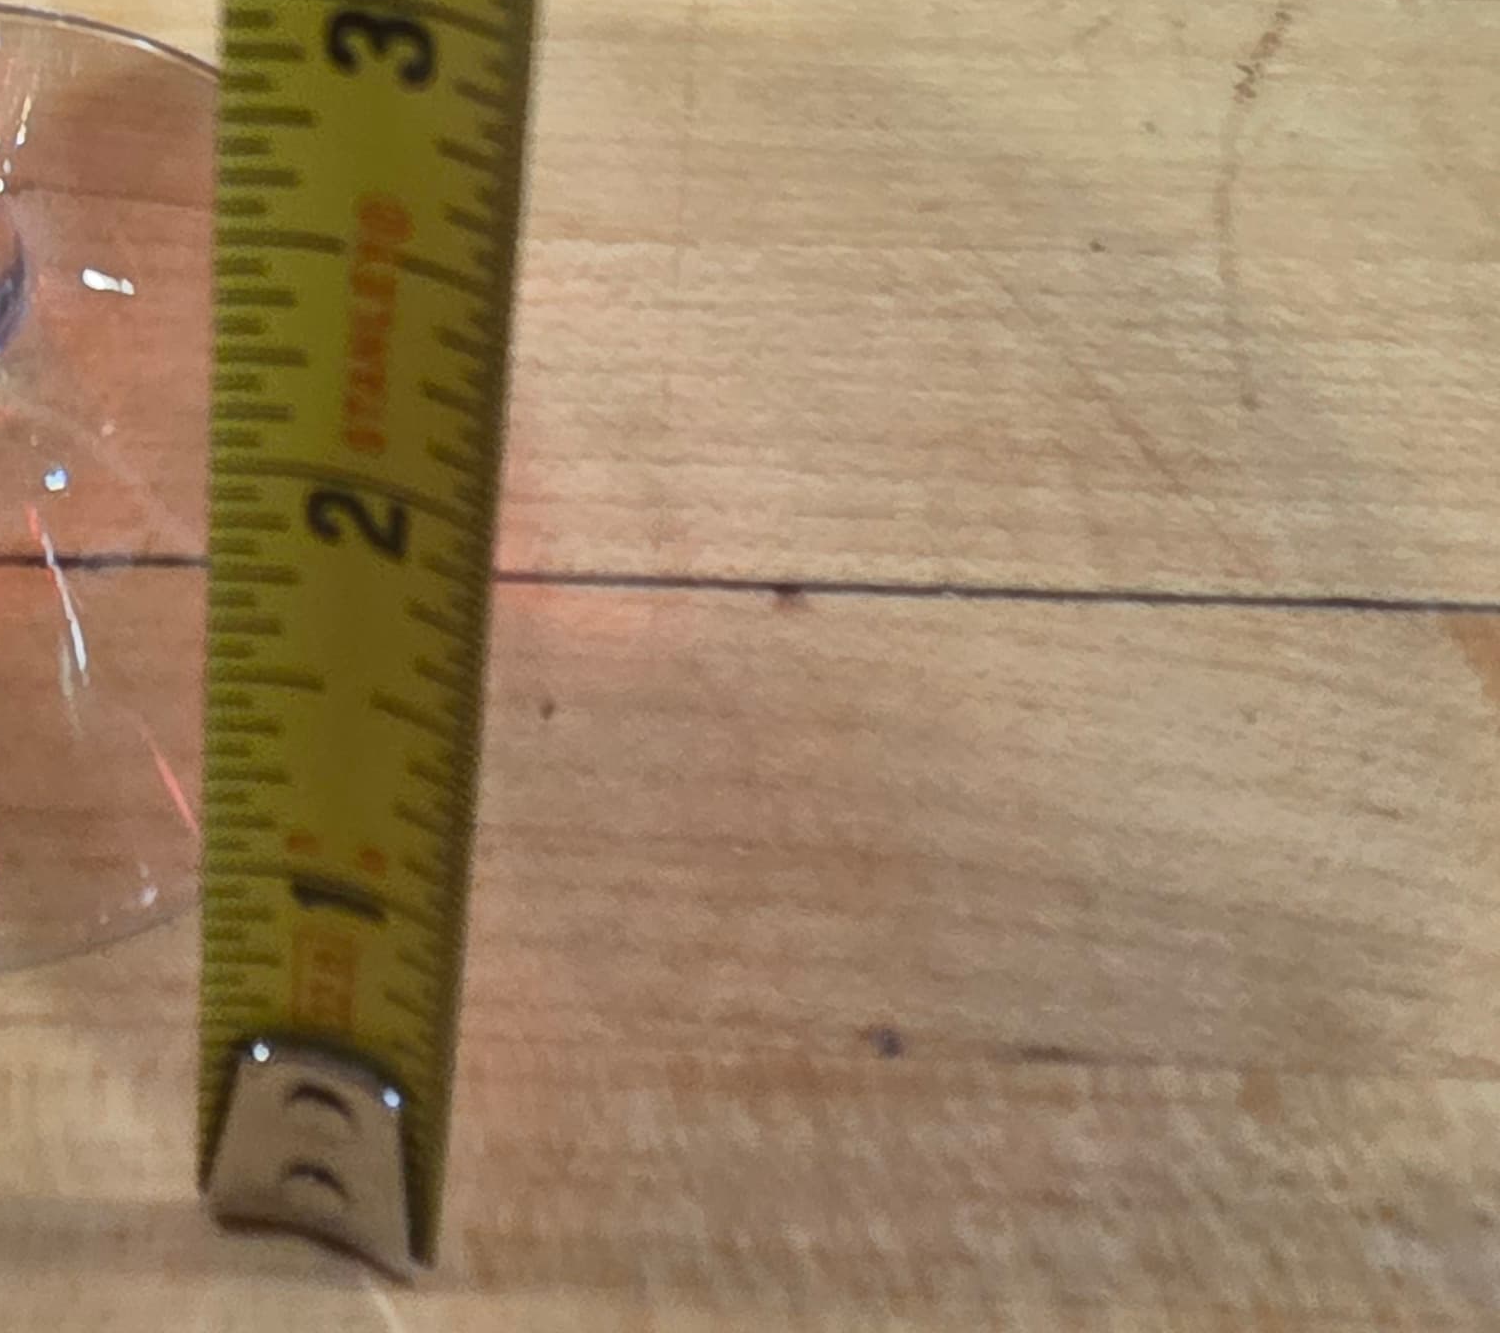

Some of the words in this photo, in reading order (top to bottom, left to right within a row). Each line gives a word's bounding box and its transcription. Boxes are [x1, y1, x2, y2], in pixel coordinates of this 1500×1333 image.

[326, 9, 437, 89] 3
[307, 490, 408, 560] 2
[291, 873, 389, 925] 1
